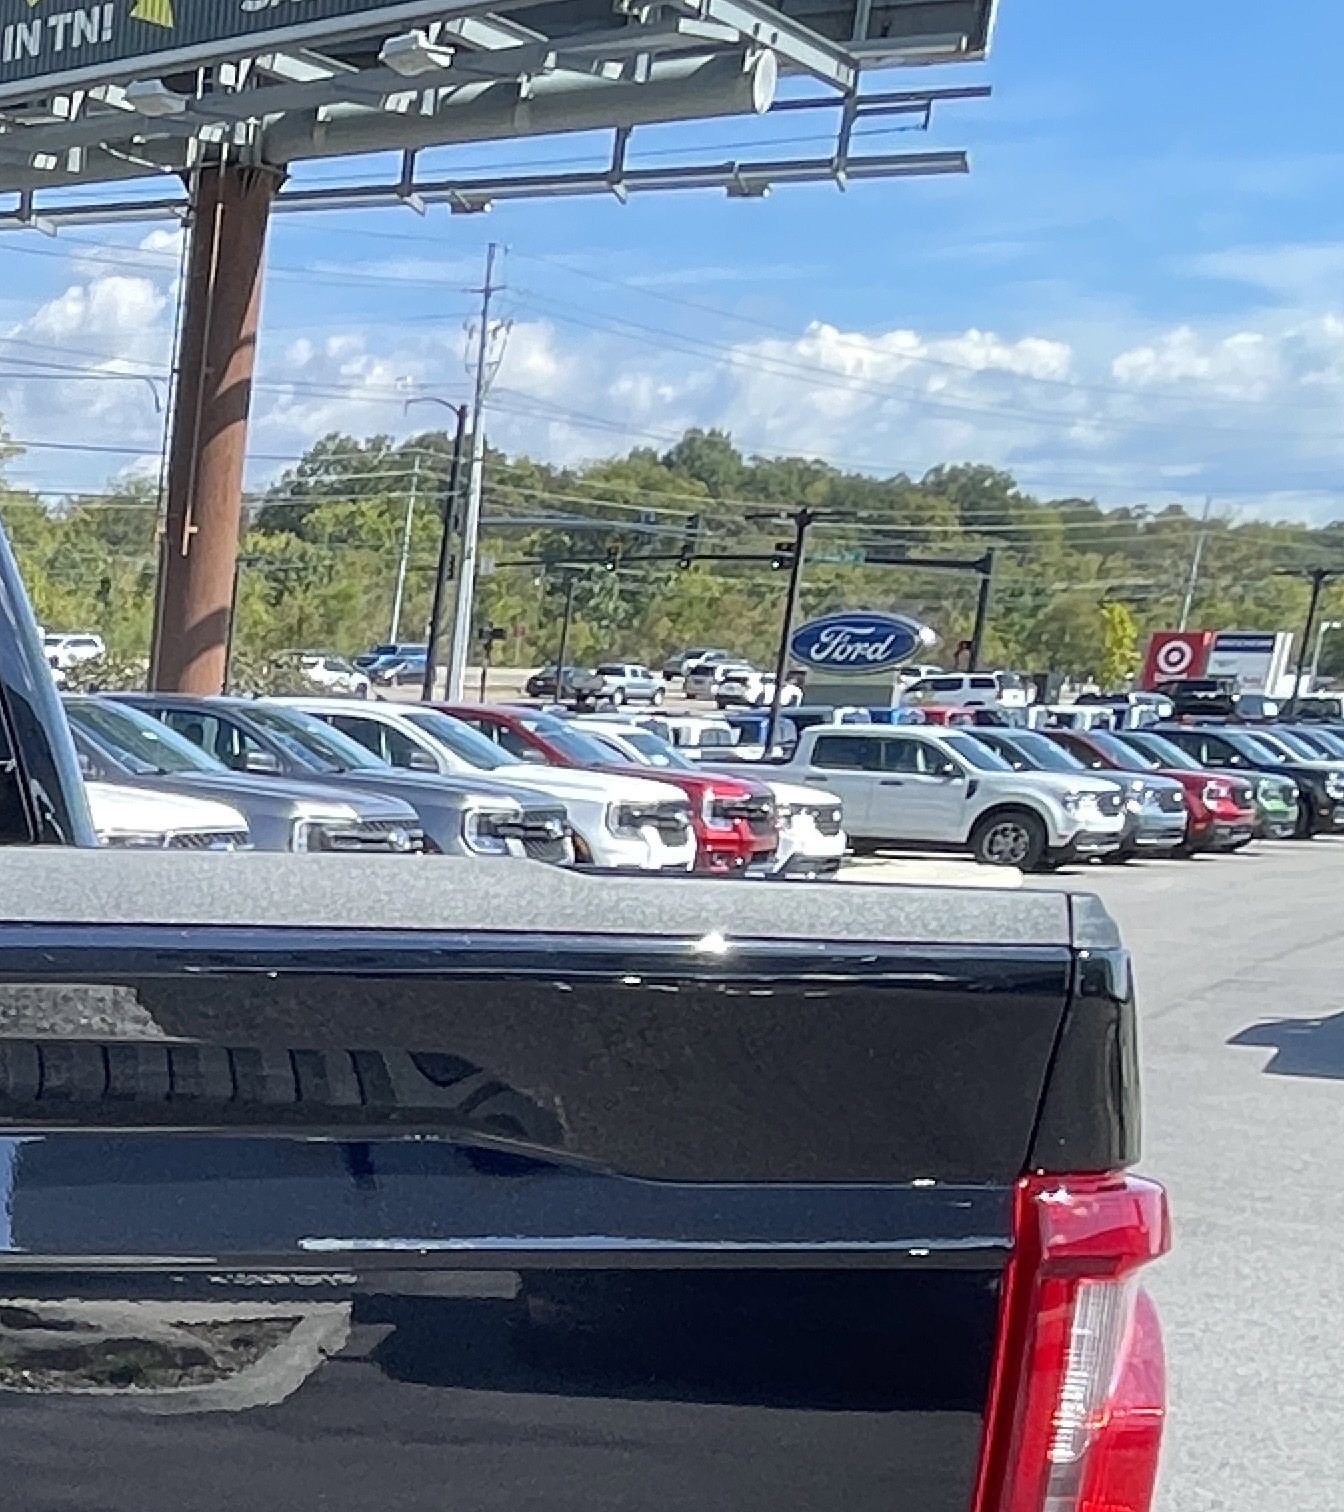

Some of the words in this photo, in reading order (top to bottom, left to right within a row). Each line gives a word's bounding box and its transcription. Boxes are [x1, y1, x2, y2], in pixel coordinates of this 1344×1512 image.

[3, 19, 41, 64] IN
[48, 4, 112, 51] TN!
[810, 626, 896, 662] Ford
